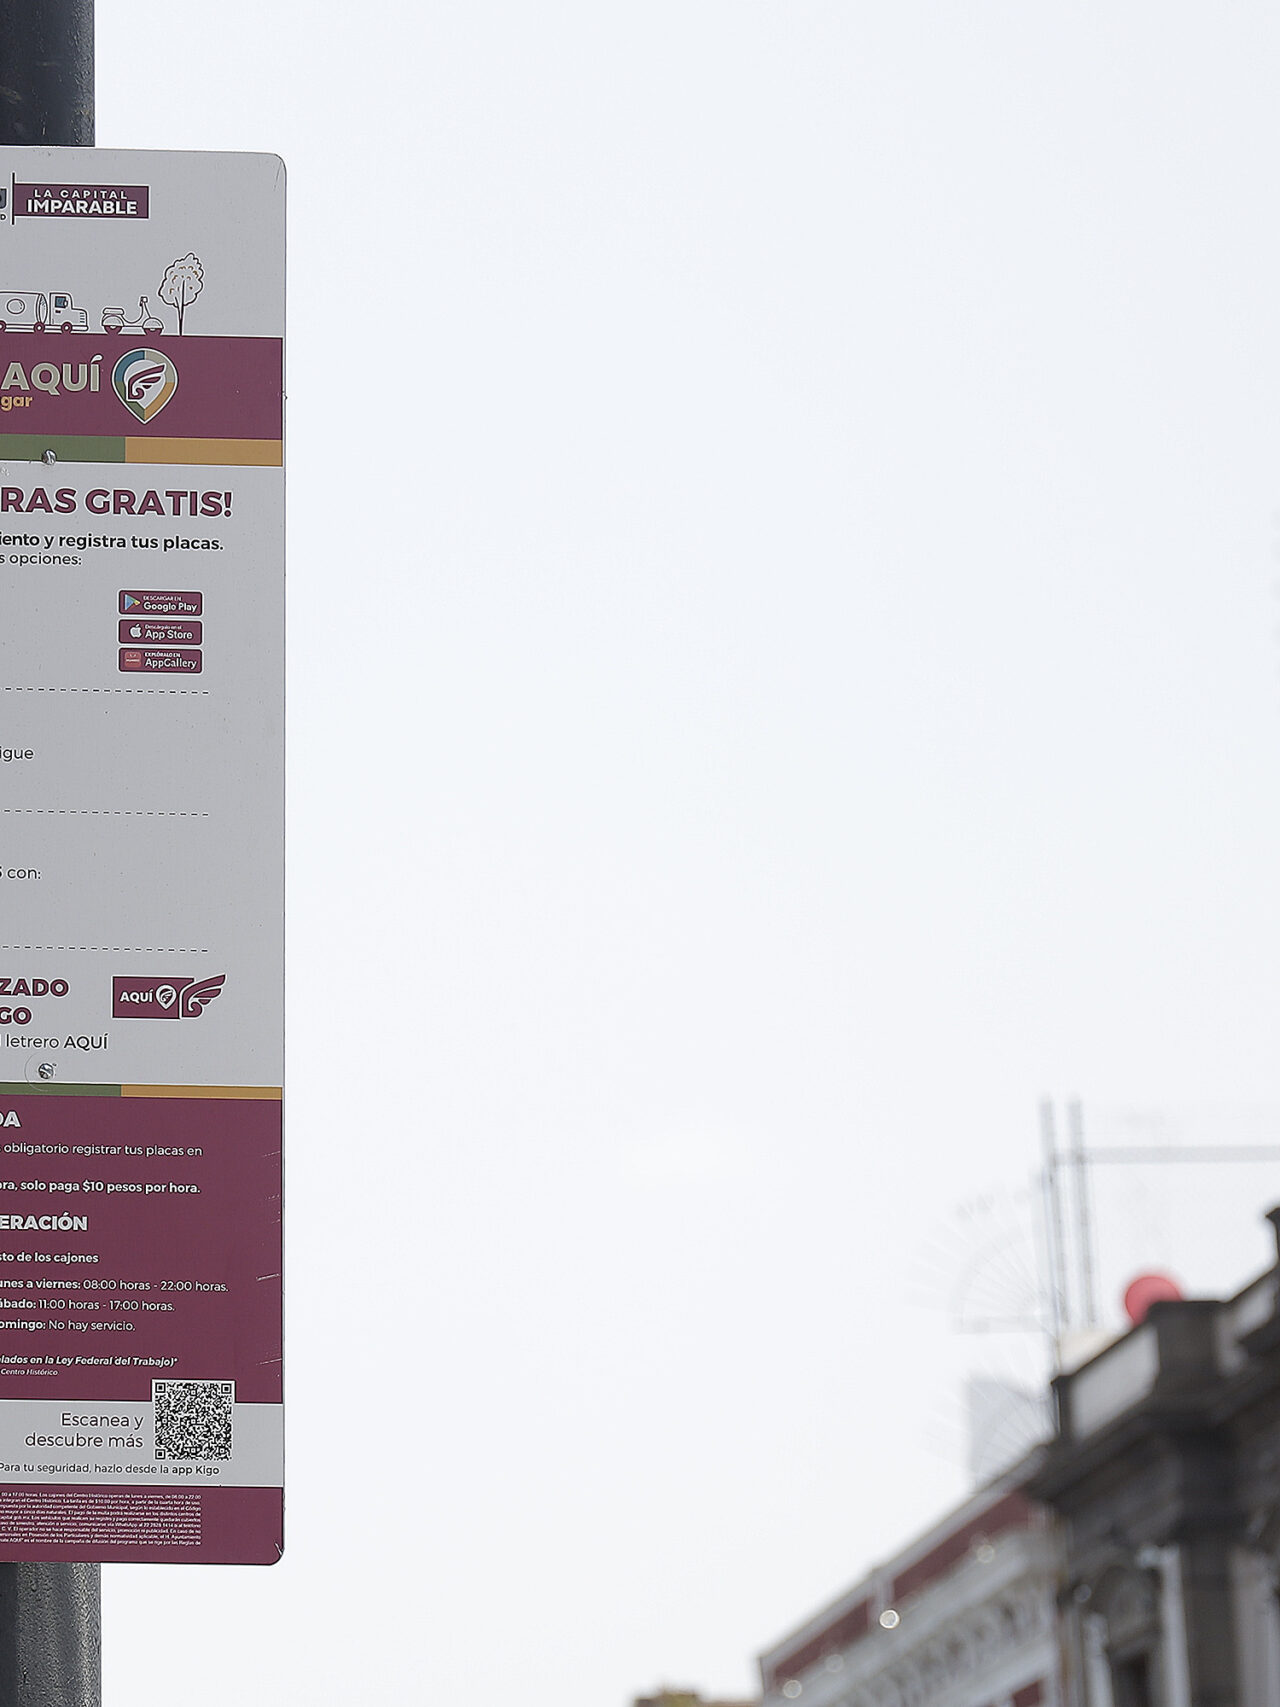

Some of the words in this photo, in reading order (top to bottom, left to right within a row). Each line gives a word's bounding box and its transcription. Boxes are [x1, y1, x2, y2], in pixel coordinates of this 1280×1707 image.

[34, 189, 52, 199] LA
[60, 190, 128, 200] CAPITAL
[26, 199, 138, 215] IMPARABLE
[85, 489, 231, 516] GRATIS!
[44, 536, 54, 549] y
[59, 533, 126, 549] registra
[131, 536, 158, 548] tus
[164, 536, 223, 551] placas.
[143, 602, 176, 612] Google
[178, 602, 197, 612] Play
[145, 630, 165, 640] App
[167, 630, 193, 639] Store
[145, 658, 197, 670] AppGallery
[7, 868, 40, 879] con:
[120, 989, 153, 1003] AQUÍ
[4, 1142, 68, 1155] obligatorio
[72, 1144, 121, 1156] registrar
[124, 1145, 142, 1154] tus
[146, 1145, 183, 1156] placas
[16, 1251, 32, 1261] de
[34, 1252, 51, 1261] los
[53, 1252, 98, 1264] cajones
[49, 1320, 64, 1329] No
[68, 1320, 88, 1331] hay
[91, 1320, 135, 1330] servicio.
[44, 1355, 54, 1364] la
[56, 1356, 73, 1366] Ley
[75, 1356, 113, 1364] Federal
[114, 1356, 130, 1365] del
[62, 1412, 129, 1426] Escanea
[134, 1416, 143, 1430] y
[25, 1432, 102, 1446] descubre
[108, 1433, 143, 1447] más
